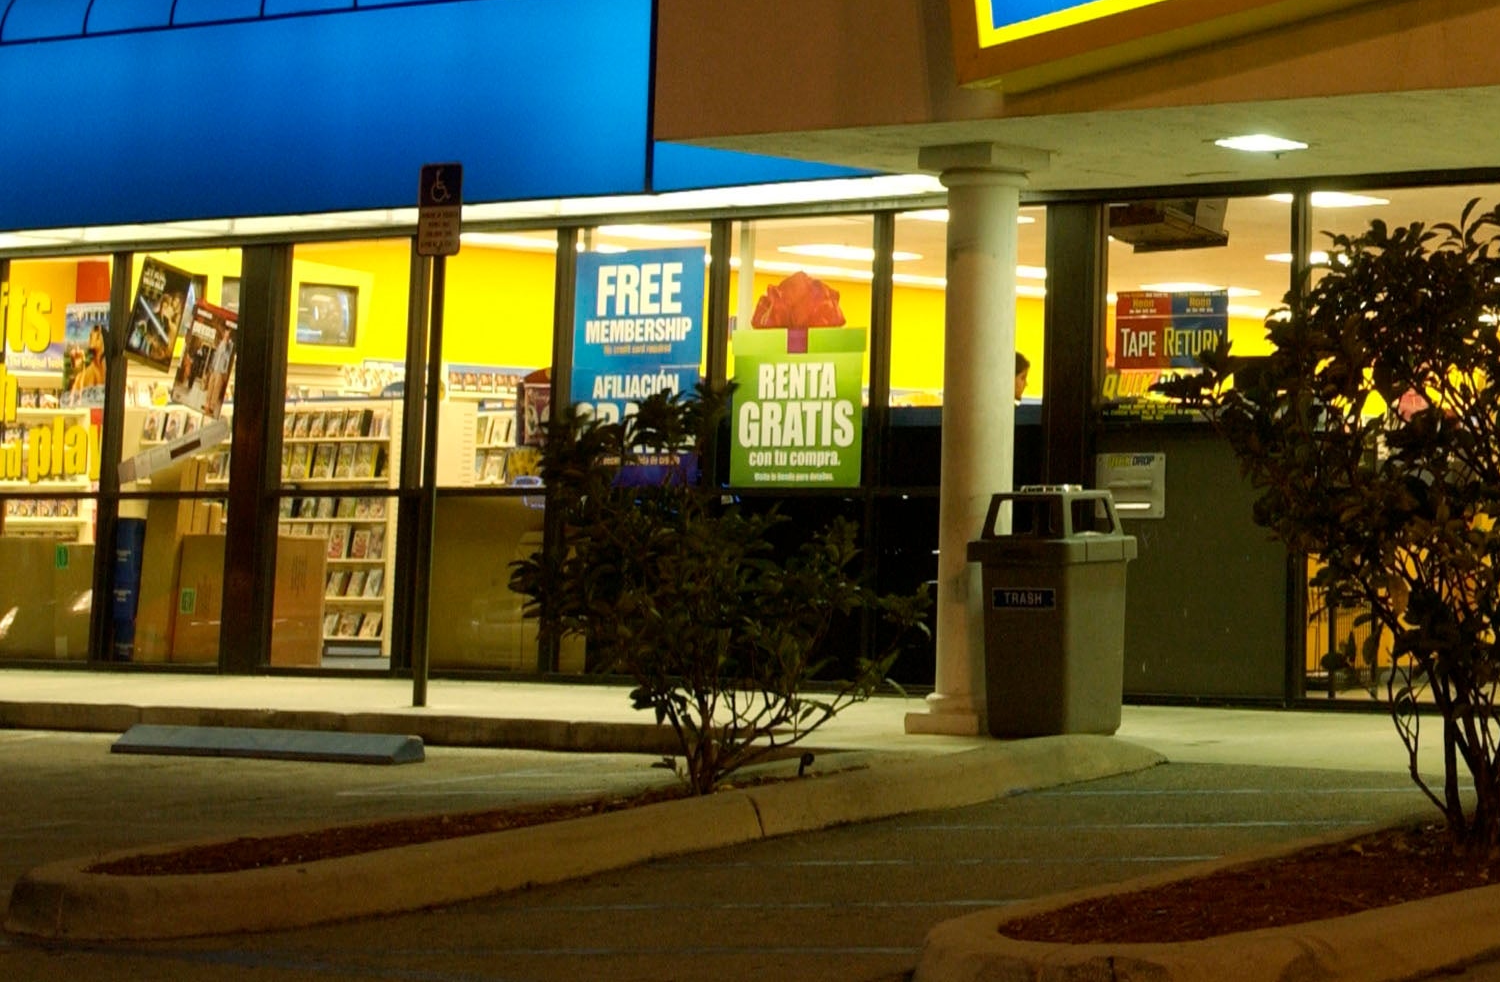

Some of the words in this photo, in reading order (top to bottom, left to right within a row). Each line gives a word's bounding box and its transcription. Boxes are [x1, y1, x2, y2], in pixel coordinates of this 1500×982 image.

[597, 262, 682, 317] FREE
[585, 317, 692, 344] MEMBERSHIP
[592, 369, 680, 400] AFILIACIÓN
[758, 362, 837, 400] RENTA
[738, 399, 855, 448] GRATIS
[749, 451, 772, 467] con
[774, 450, 787, 466] tu
[789, 451, 841, 468] compra.
[1004, 592, 1043, 606] TRASH
